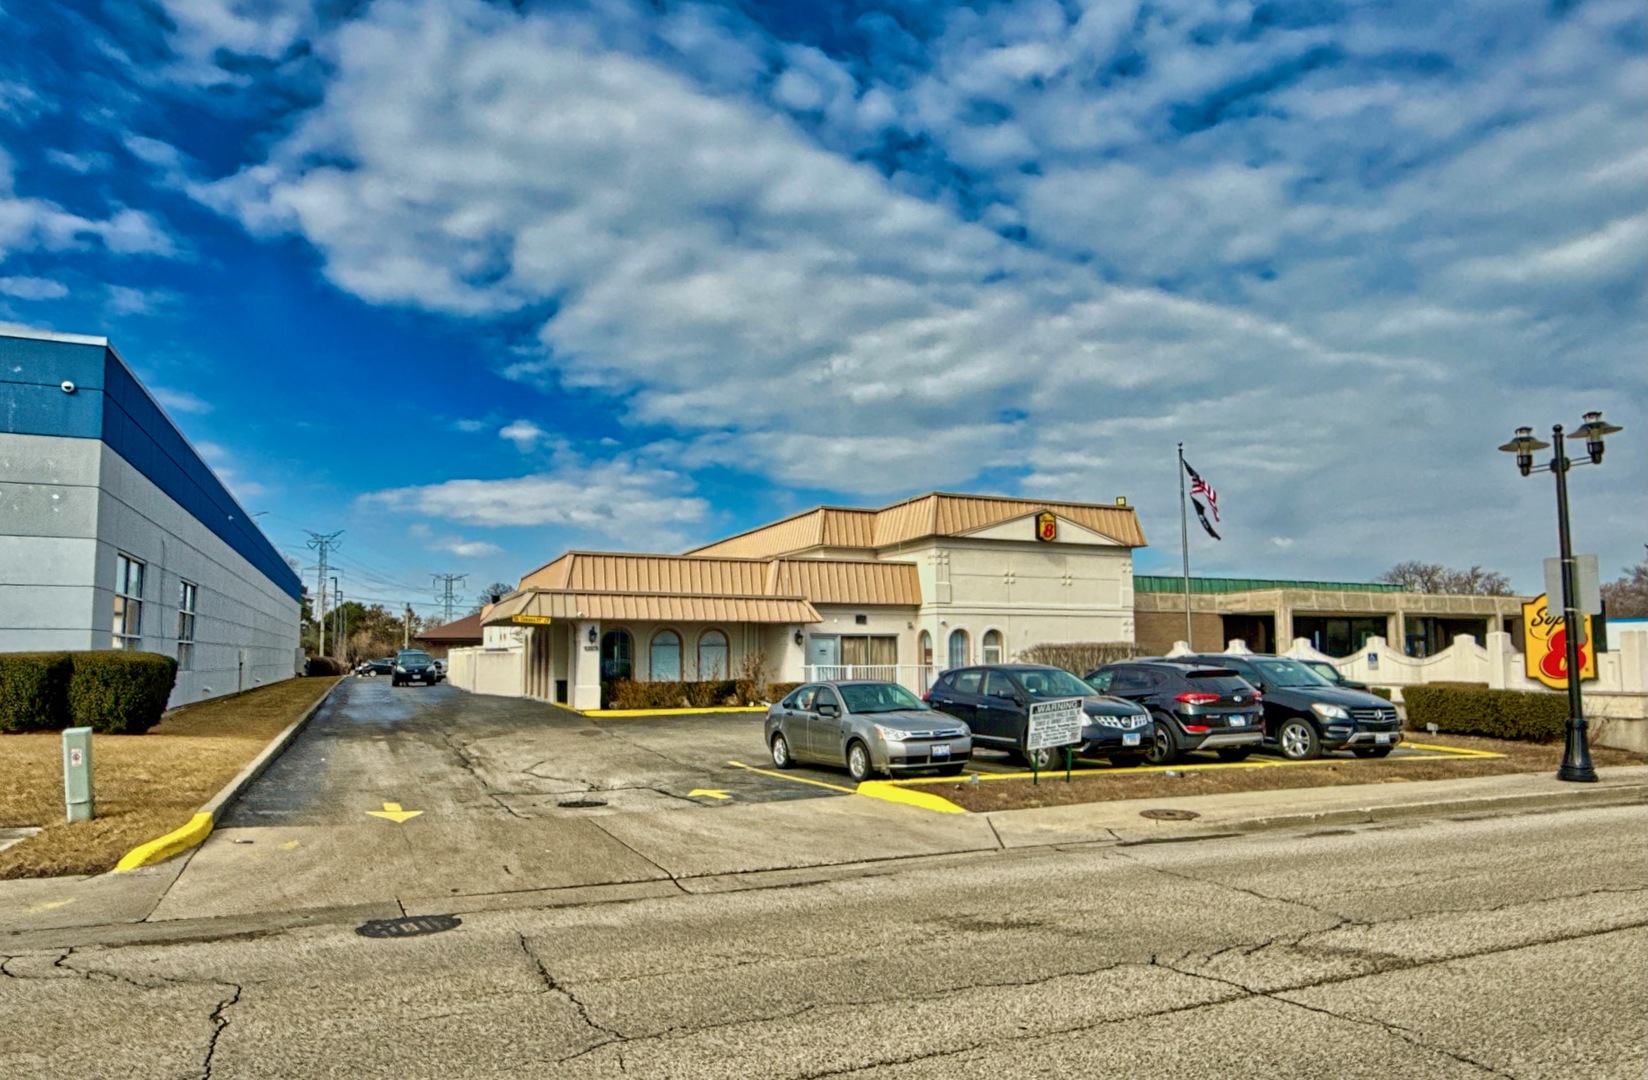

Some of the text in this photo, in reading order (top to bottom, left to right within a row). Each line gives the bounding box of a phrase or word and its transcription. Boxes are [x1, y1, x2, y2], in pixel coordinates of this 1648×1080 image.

[1043, 523, 1054, 538] 8
[1530, 606, 1588, 636] Sup
[1539, 629, 1588, 679] 8
[1037, 701, 1078, 713] WARNING
